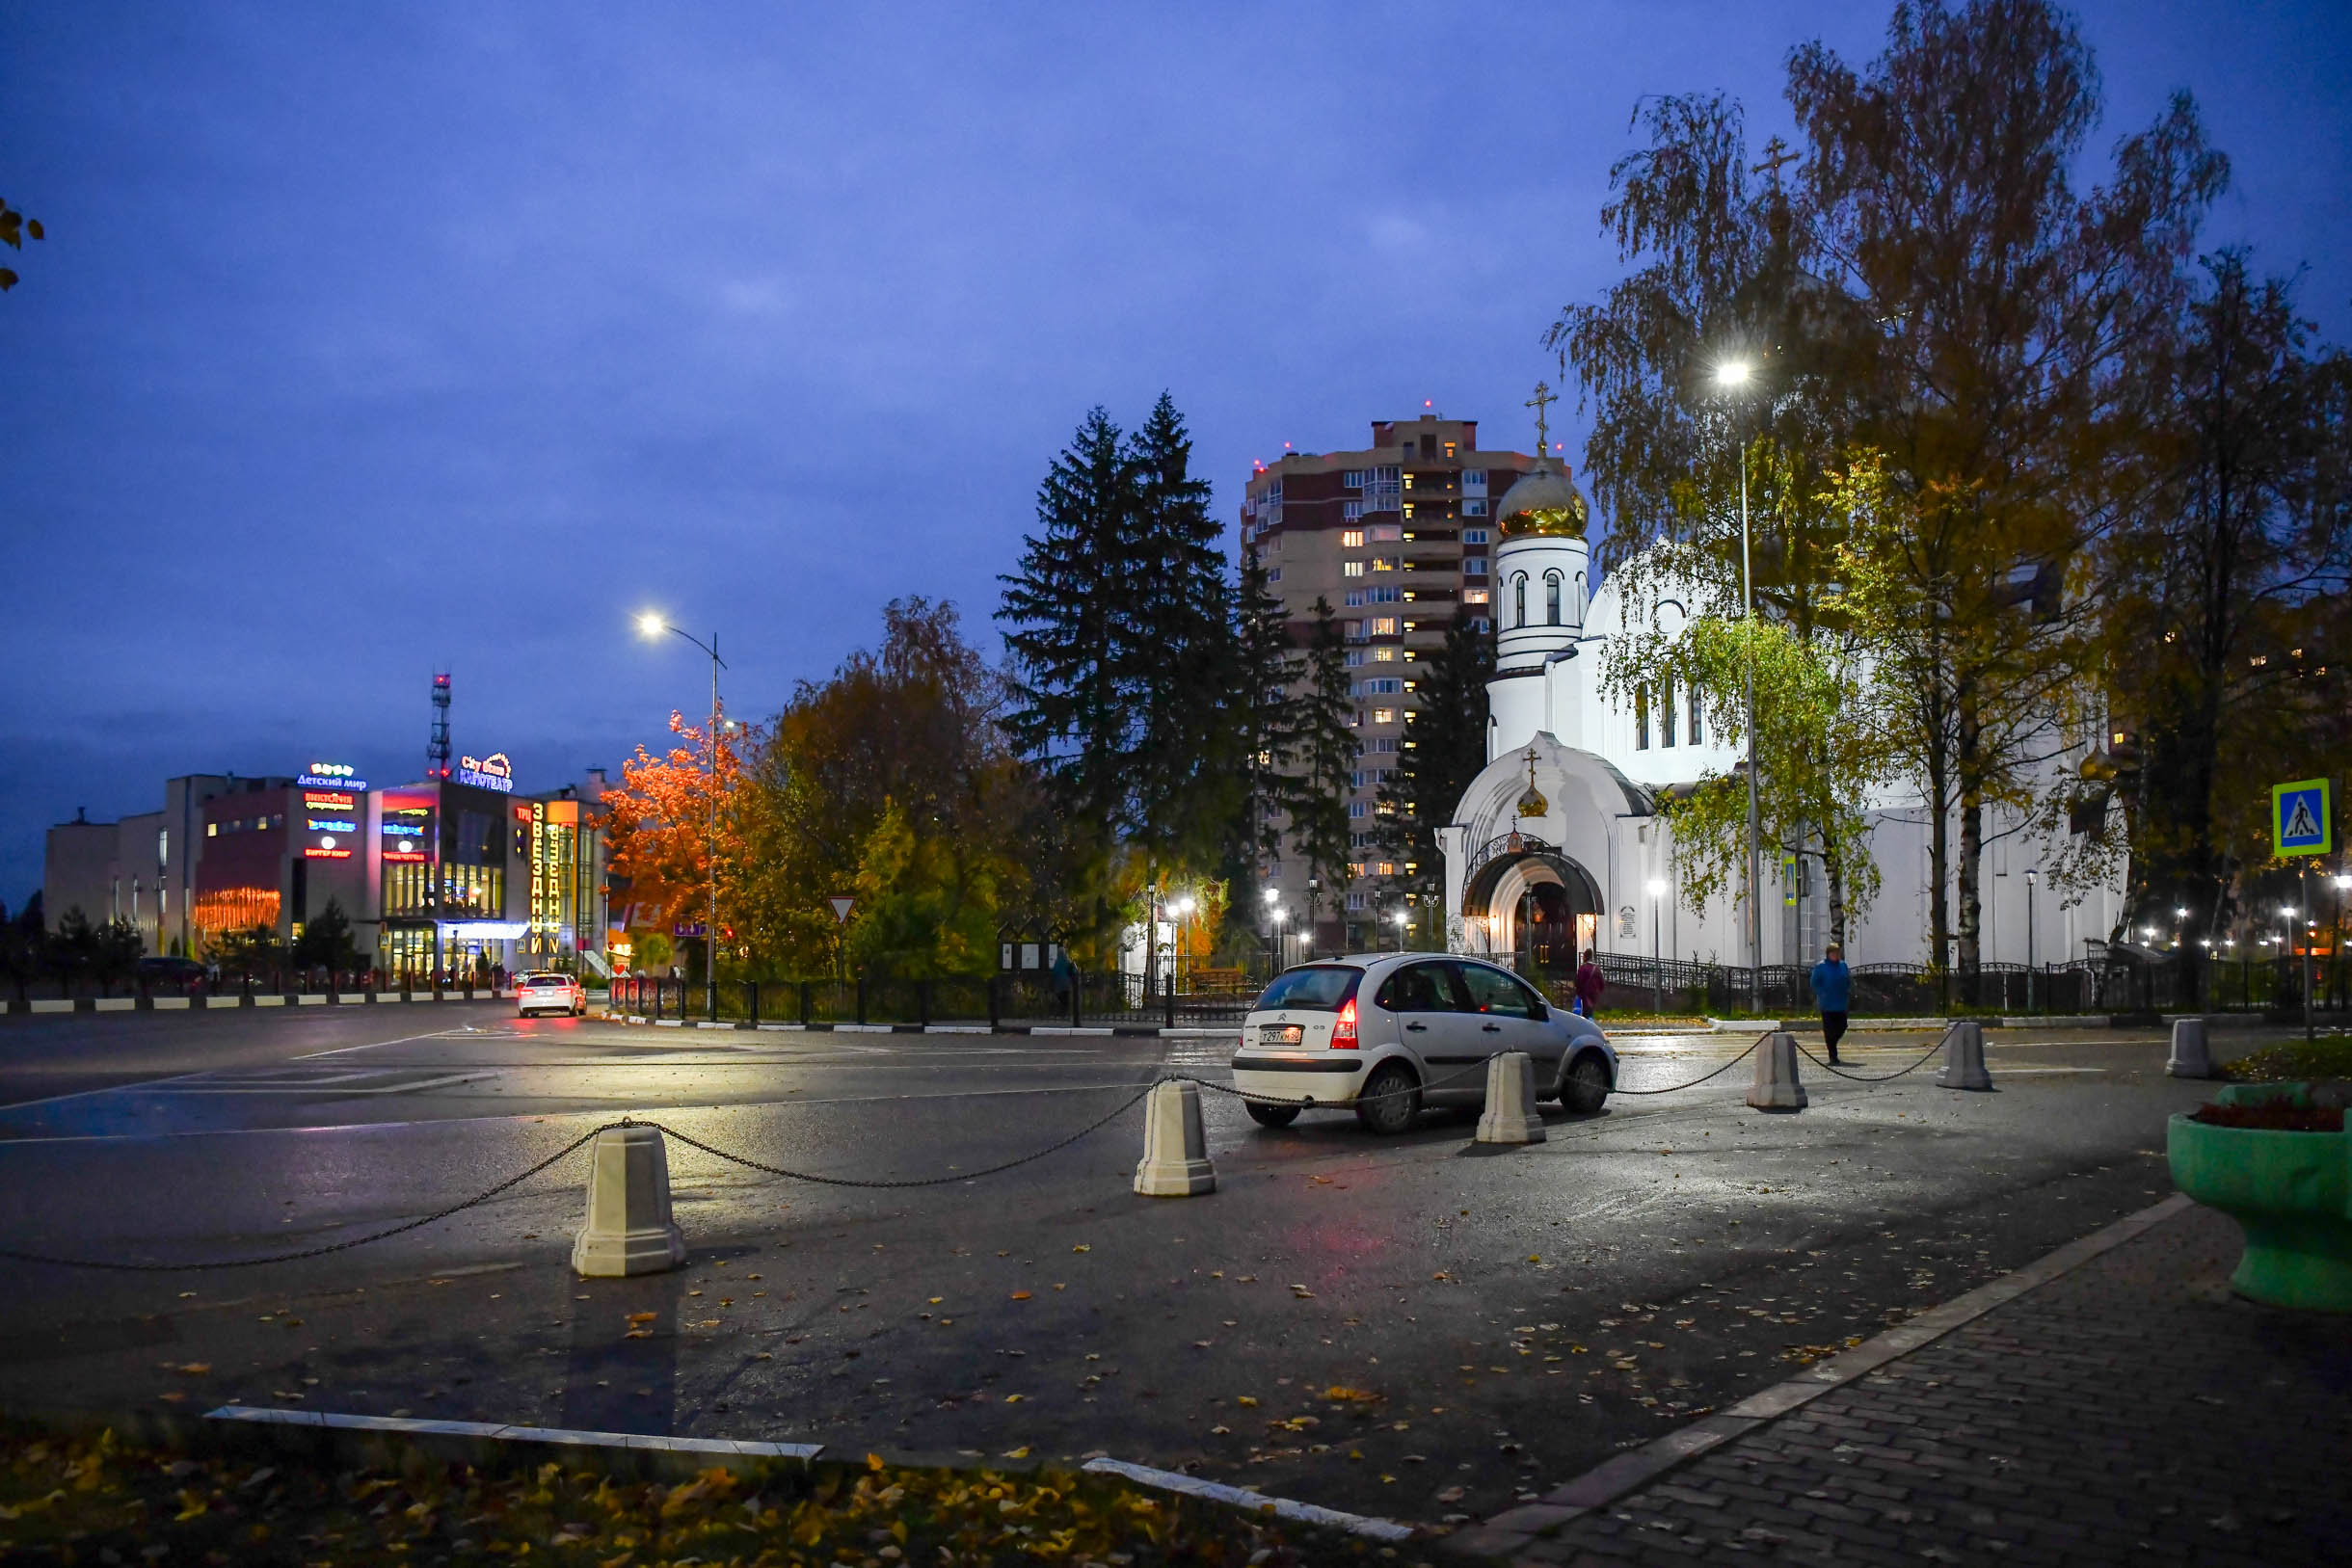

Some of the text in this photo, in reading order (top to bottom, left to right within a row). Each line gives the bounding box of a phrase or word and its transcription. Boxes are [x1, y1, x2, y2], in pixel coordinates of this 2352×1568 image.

[462, 756, 481, 773] City
[297, 774, 366, 791] Детский мир
[459, 769, 513, 792] КИНОТЕАТР
[517, 808, 532, 823] ТРЦ
